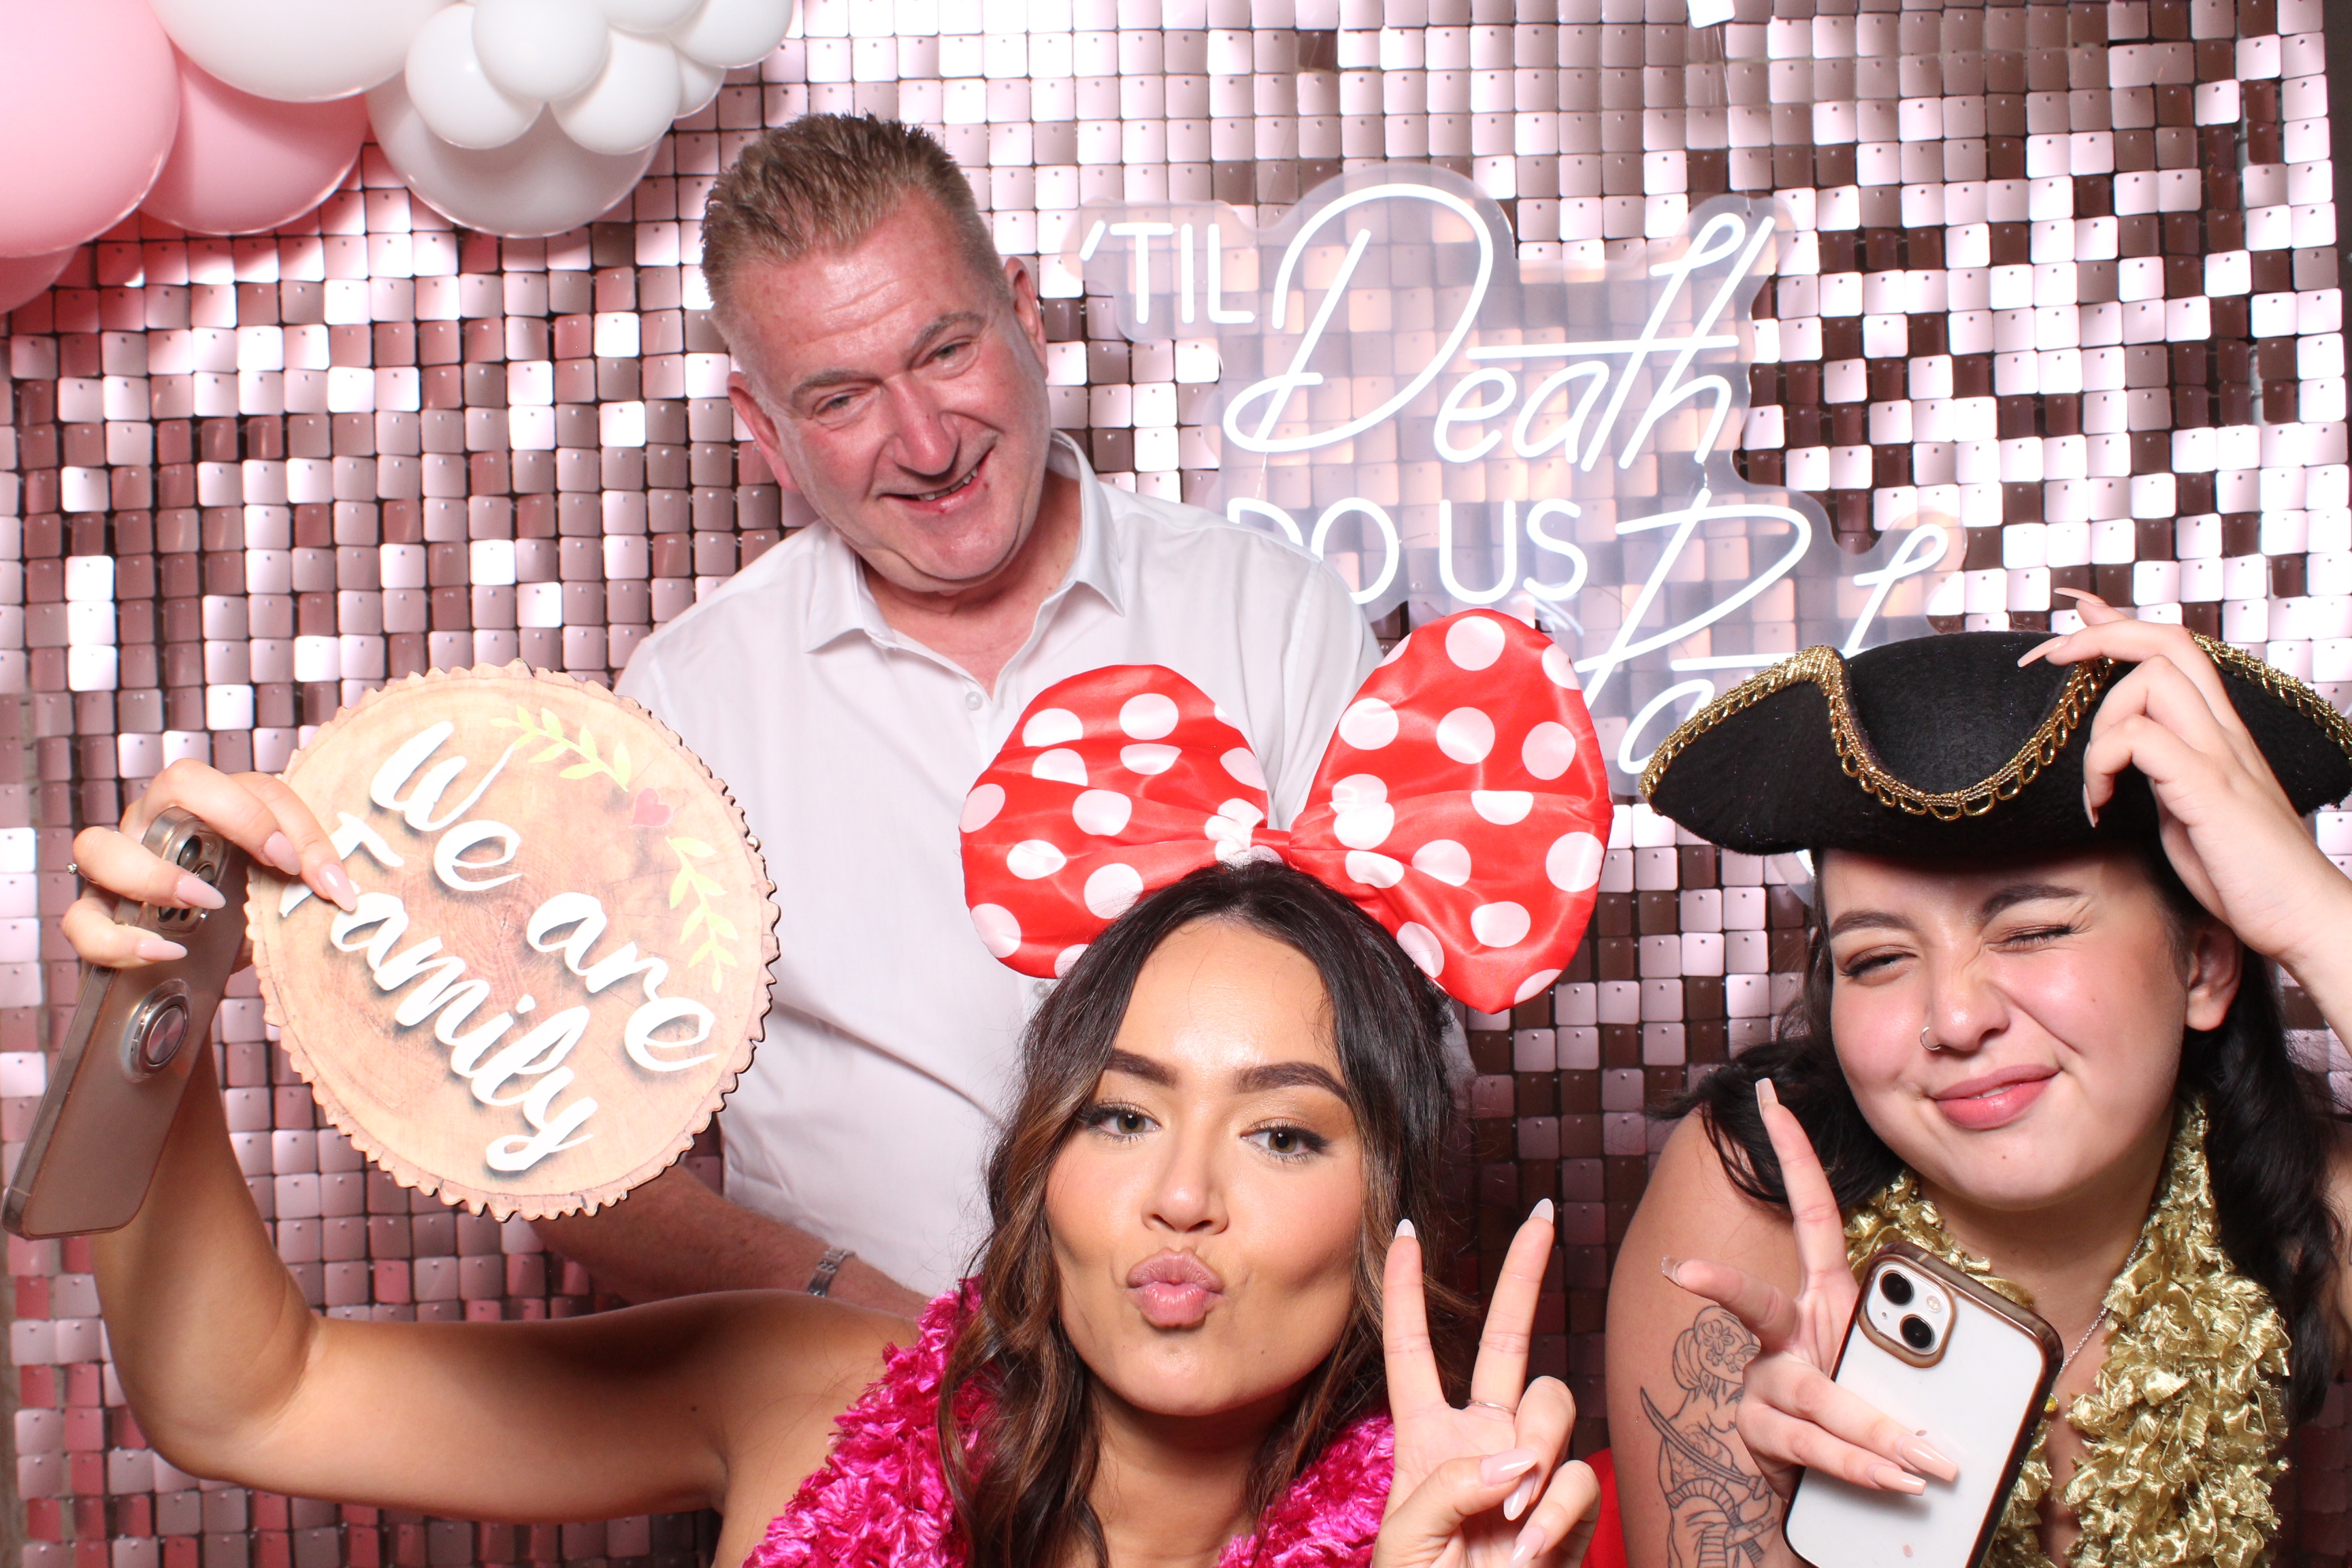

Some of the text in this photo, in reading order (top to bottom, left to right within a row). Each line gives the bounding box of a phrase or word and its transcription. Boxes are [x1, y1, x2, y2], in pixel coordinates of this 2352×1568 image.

[1223, 183, 1776, 473] Death
[1439, 498, 1588, 605] US
[1573, 487, 1948, 774] Pat
[370, 720, 719, 1073] We are
